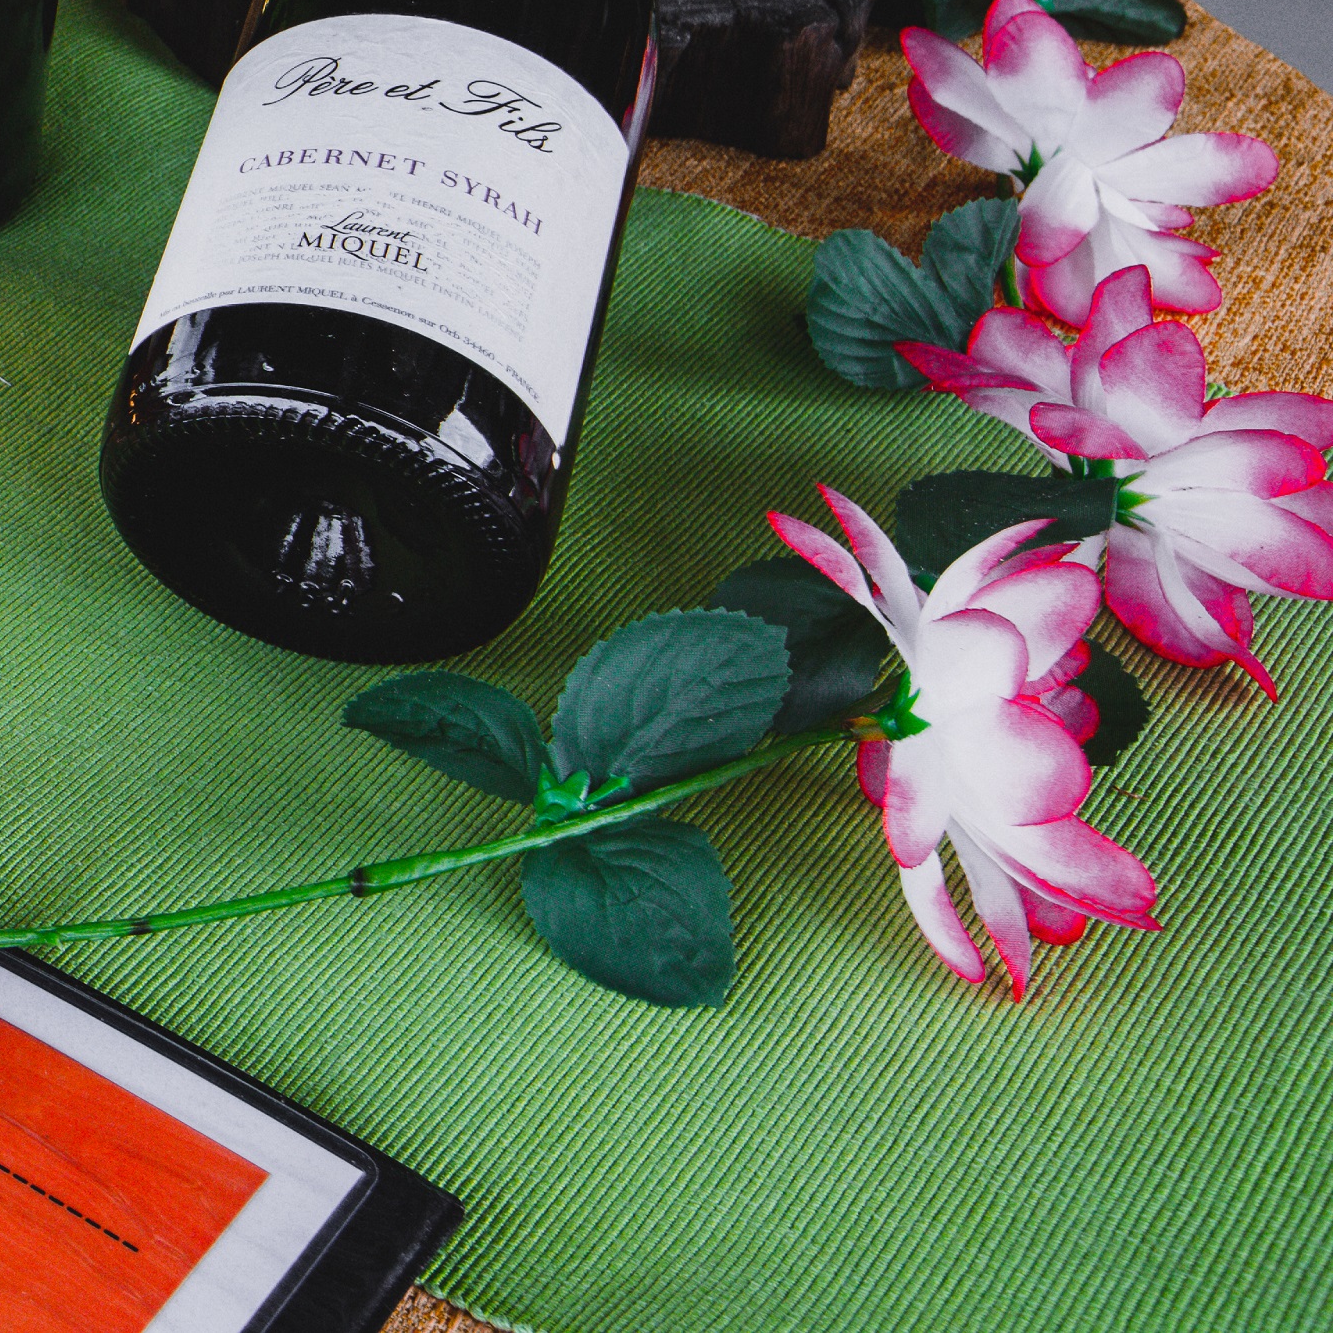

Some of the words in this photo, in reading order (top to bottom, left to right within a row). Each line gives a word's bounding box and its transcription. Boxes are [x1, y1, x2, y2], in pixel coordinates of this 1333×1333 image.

[262, 57, 379, 106] Père
[384, 79, 441, 101] et
[438, 80, 562, 153] Fils
[238, 147, 426, 177] CABERNET
[440, 169, 544, 238] SYRAH
[319, 210, 422, 244] Laurent
[297, 231, 428, 273] MIQUEL
[237, 285, 294, 295] LAURENT
[296, 285, 348, 301] MIQUEL
[439, 324, 461, 340] Orb
[505, 364, 541, 404] FRANCE
